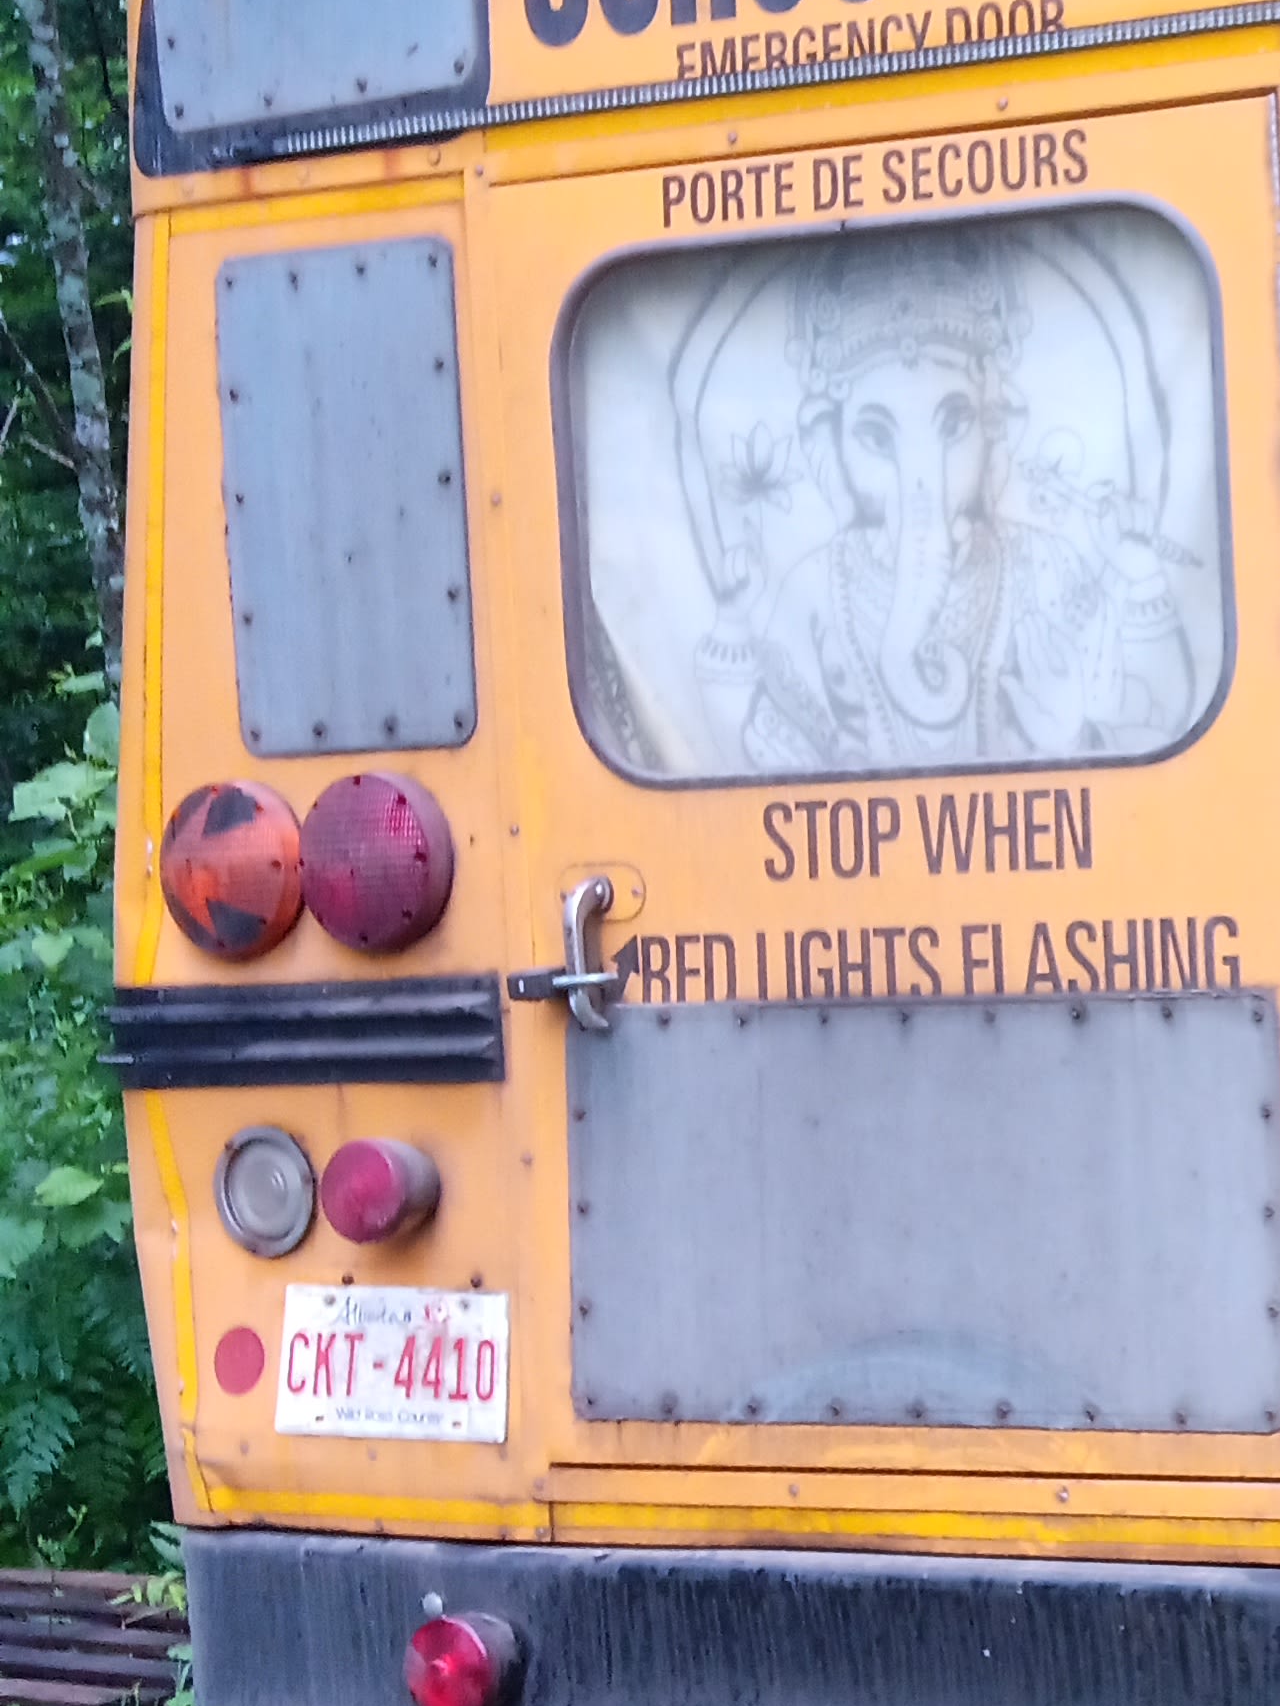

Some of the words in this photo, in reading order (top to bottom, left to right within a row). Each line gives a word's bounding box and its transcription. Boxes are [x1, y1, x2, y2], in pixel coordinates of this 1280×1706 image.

[663, 163, 796, 228] PORTE
[813, 154, 866, 209] DE
[881, 129, 1088, 204] SECOURS
[763, 797, 901, 882] STOP
[917, 788, 1092, 873] WHEN
[756, 926, 942, 999] LIGHTS
